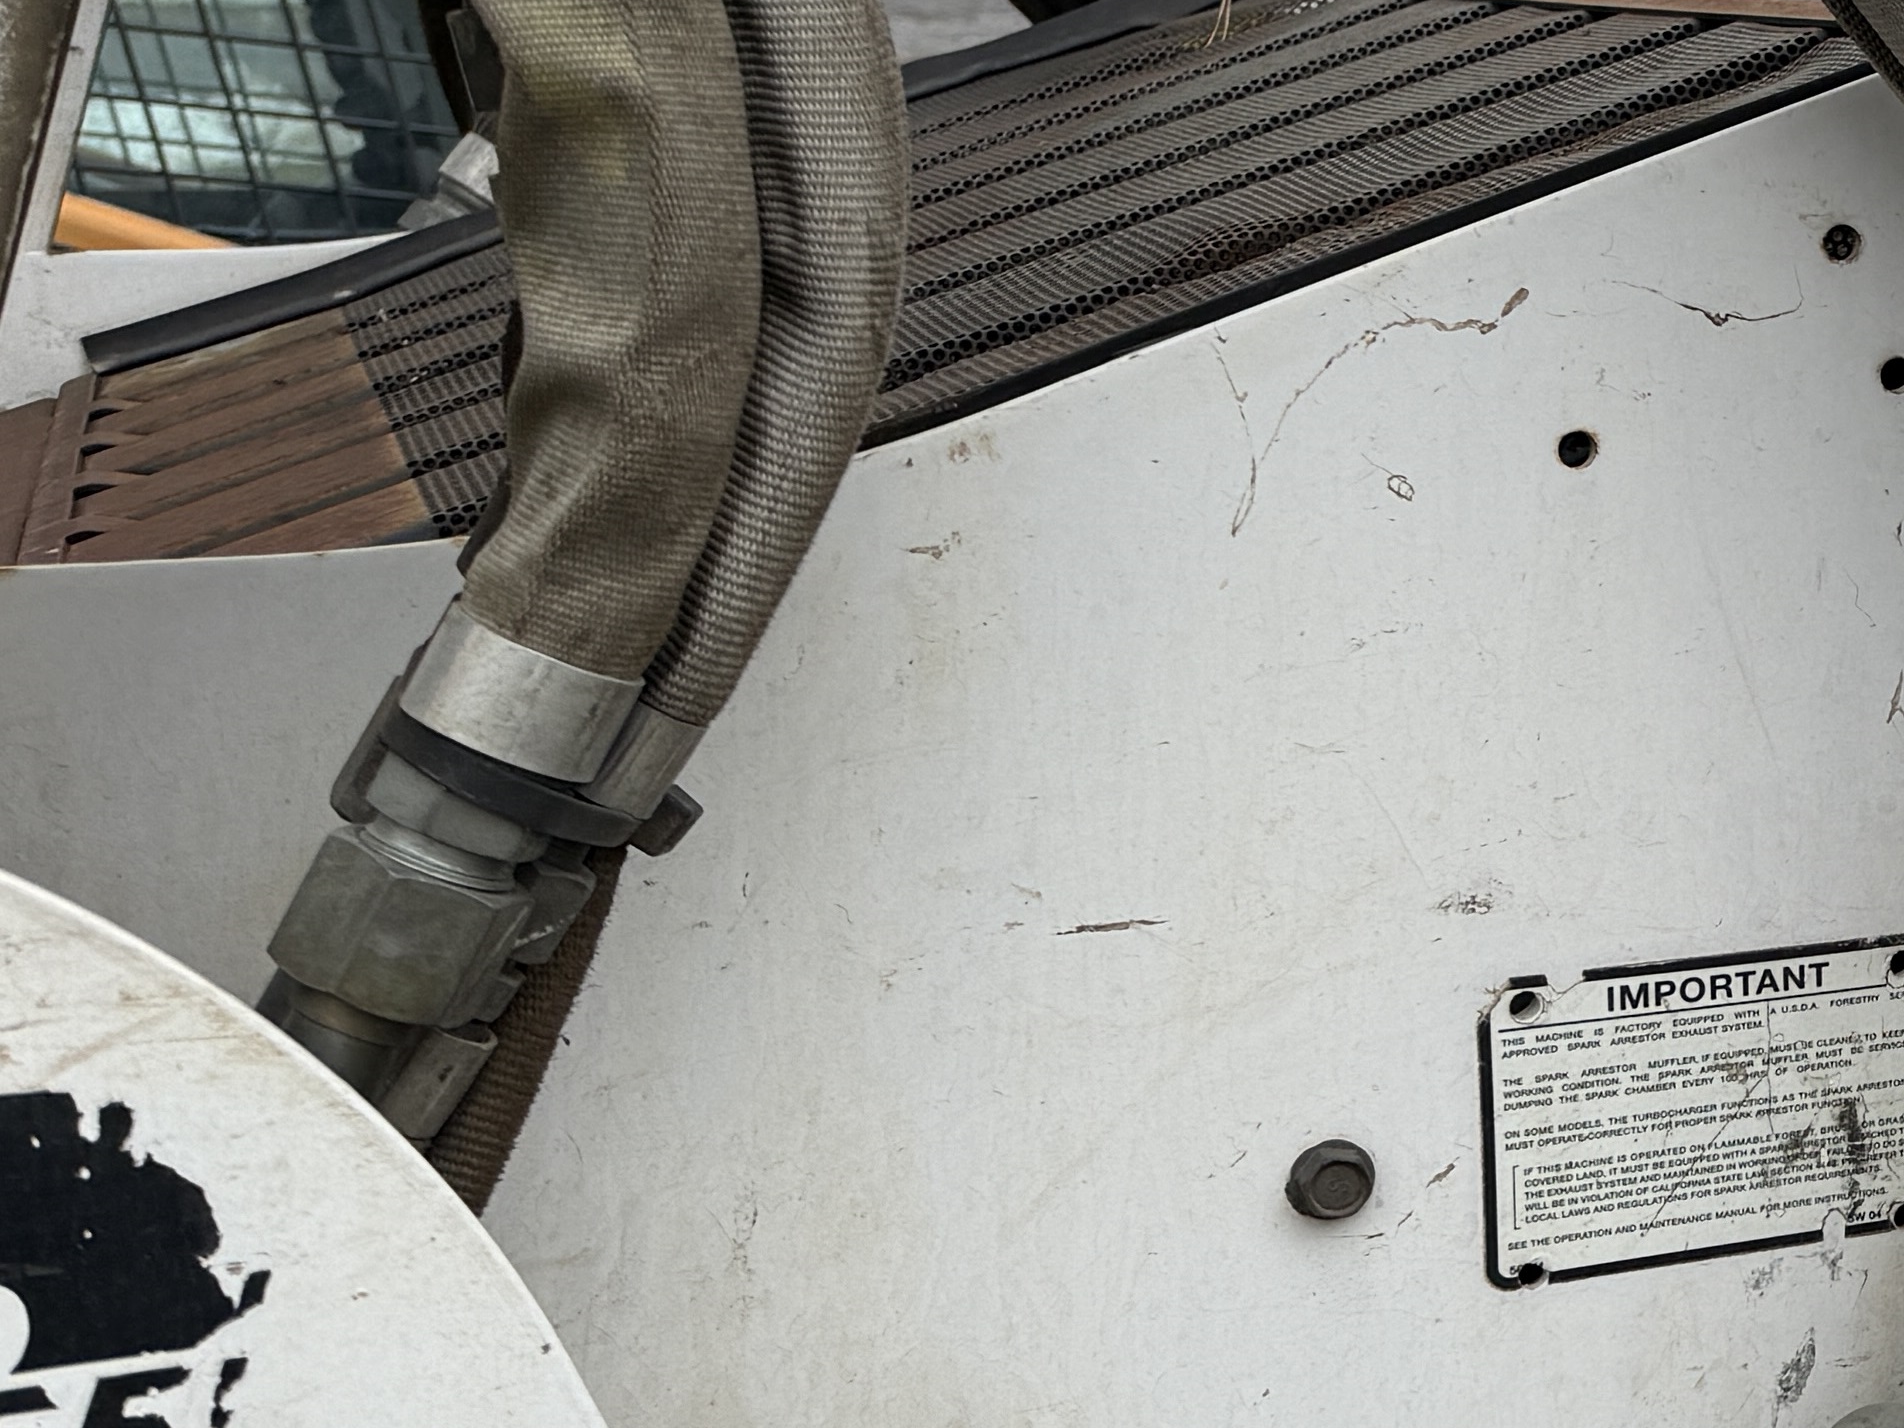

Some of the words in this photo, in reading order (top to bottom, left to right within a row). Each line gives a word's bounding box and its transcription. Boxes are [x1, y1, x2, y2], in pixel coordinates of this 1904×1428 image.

[1607, 961, 1829, 1011] IMPORTANT
[1501, 1037, 1524, 1047] THIS
[1535, 1030, 1583, 1043] MACHINE
[1594, 1027, 1603, 1036] IS
[1614, 1020, 1661, 1033] FACTORY
[1672, 1013, 1724, 1026] EQUIPPED
[1734, 1008, 1759, 1019] WITH
[1770, 1006, 1776, 1014] A
[1830, 994, 1879, 1007] FORESTRY
[1501, 1045, 1558, 1059] APPROVED
[1567, 1040, 1600, 1051] SPARK
[1610, 1032, 1665, 1046] ARRESTOR
[1672, 1025, 1717, 1038] EXHAUST
[1721, 1020, 1764, 1032] SYSTEM.
[1502, 1077, 1522, 1087] THE
[1535, 1071, 1569, 1083] SPARK
[1580, 1063, 1636, 1077] ARRESTOR
[1701, 1053, 1710, 1062] IF
[1865, 1032, 1876, 1041] TO
[1502, 1085, 1553, 1099] WORKING
[1630, 1073, 1649, 1083] THE
[1658, 1067, 1691, 1079] SPARK
[1699, 1059, 1753, 1074] ARRESTOR
[1762, 1052, 1808, 1066] MUFFLER
[1815, 1048, 1842, 1059] MUST
[1850, 1045, 1863, 1054] BE
[1503, 1097, 1552, 1111] DUMPING
[1558, 1094, 1579, 1104] THE
[1585, 1089, 1618, 1100] SPARK
[1624, 1081, 1675, 1095] CHAMBER
[1682, 1076, 1713, 1088] EVERY
[1721, 1073, 1737, 1082] 100
[1775, 1067, 1788, 1075] OF
[1504, 1129, 1519, 1139] ON
[1523, 1125, 1553, 1136] SOME
[1608, 1115, 1627, 1125] THE
[1632, 1103, 1716, 1122] TURBOCHARGER
[1721, 1095, 1778, 1110] FUNCTIONS
[1782, 1093, 1794, 1102] AS
[1798, 1090, 1817, 1099] THE
[1821, 1085, 1852, 1096] SPARK
[1505, 1140, 1533, 1151] MUST
[1587, 1124, 1648, 1140] CORRECTLY
[1651, 1121, 1672, 1131] FOR
[1675, 1115, 1716, 1128] PROPER
[1719, 1110, 1752, 1122] SPARK
[1755, 1103, 1807, 1117] ARRESTOR
[1523, 1167, 1533, 1176] IF
[1537, 1163, 1561, 1174] THIS
[1564, 1156, 1613, 1170] MACHINE
[1617, 1154, 1626, 1163] IS
[1630, 1145, 1686, 1161] OPERATED
[1689, 1143, 1704, 1152] ON
[1707, 1134, 1772, 1150] FLAMMABLE
[1861, 1119, 1875, 1128] OR
[1524, 1173, 1573, 1188] COVERED
[1609, 1167, 1617, 1176] IT
[1620, 1162, 1648, 1174] MUST
[1652, 1160, 1664, 1169] BE
[1668, 1152, 1719, 1167] EQUIPPED
[1722, 1149, 1746, 1160] WITH
[1750, 1147, 1756, 1156] A
[1524, 1189, 1544, 1200] THE
[1547, 1182, 1593, 1196] EXHAUST
[1596, 1176, 1636, 1189] SYSTEM
[1639, 1173, 1660, 1183] AND
[1663, 1164, 1722, 1180] MAINTAINED
[1726, 1162, 1735, 1171] IN
[1739, 1155, 1785, 1169] WORKING
[1882, 1139, 1895, 1148] DO
[1524, 1201, 1548, 1212] WILL
[1552, 1198, 1564, 1208] BE
[1567, 1196, 1577, 1206] IN
[1580, 1188, 1632, 1204] VIOLATION
[1635, 1186, 1648, 1196] OF
[1651, 1177, 1710, 1193] CALIFORNIA
[1713, 1173, 1742, 1184] STATE
[1770, 1162, 1812, 1176] SECTION
[1508, 1240, 1527, 1250] SEE
[1531, 1237, 1549, 1247] THE
[1554, 1227, 1611, 1243] OPERATION
[1614, 1224, 1636, 1234] AND
[1639, 1212, 1711, 1230] MAINTENANCE
[1715, 1206, 1756, 1219] MANUAL
[1760, 1202, 1780, 1212] FOR
[1785, 1198, 1811, 1209] MORE
[1525, 1211, 1557, 1223] LOCAL
[1561, 1206, 1590, 1218] LAWS
[1594, 1203, 1614, 1213] AND
[1617, 1192, 1687, 1210] REGULATIONS
[1691, 1189, 1710, 1199] FOR
[1713, 1184, 1744, 1196] SPARK
[1748, 1176, 1801, 1190] ARRESTOR
